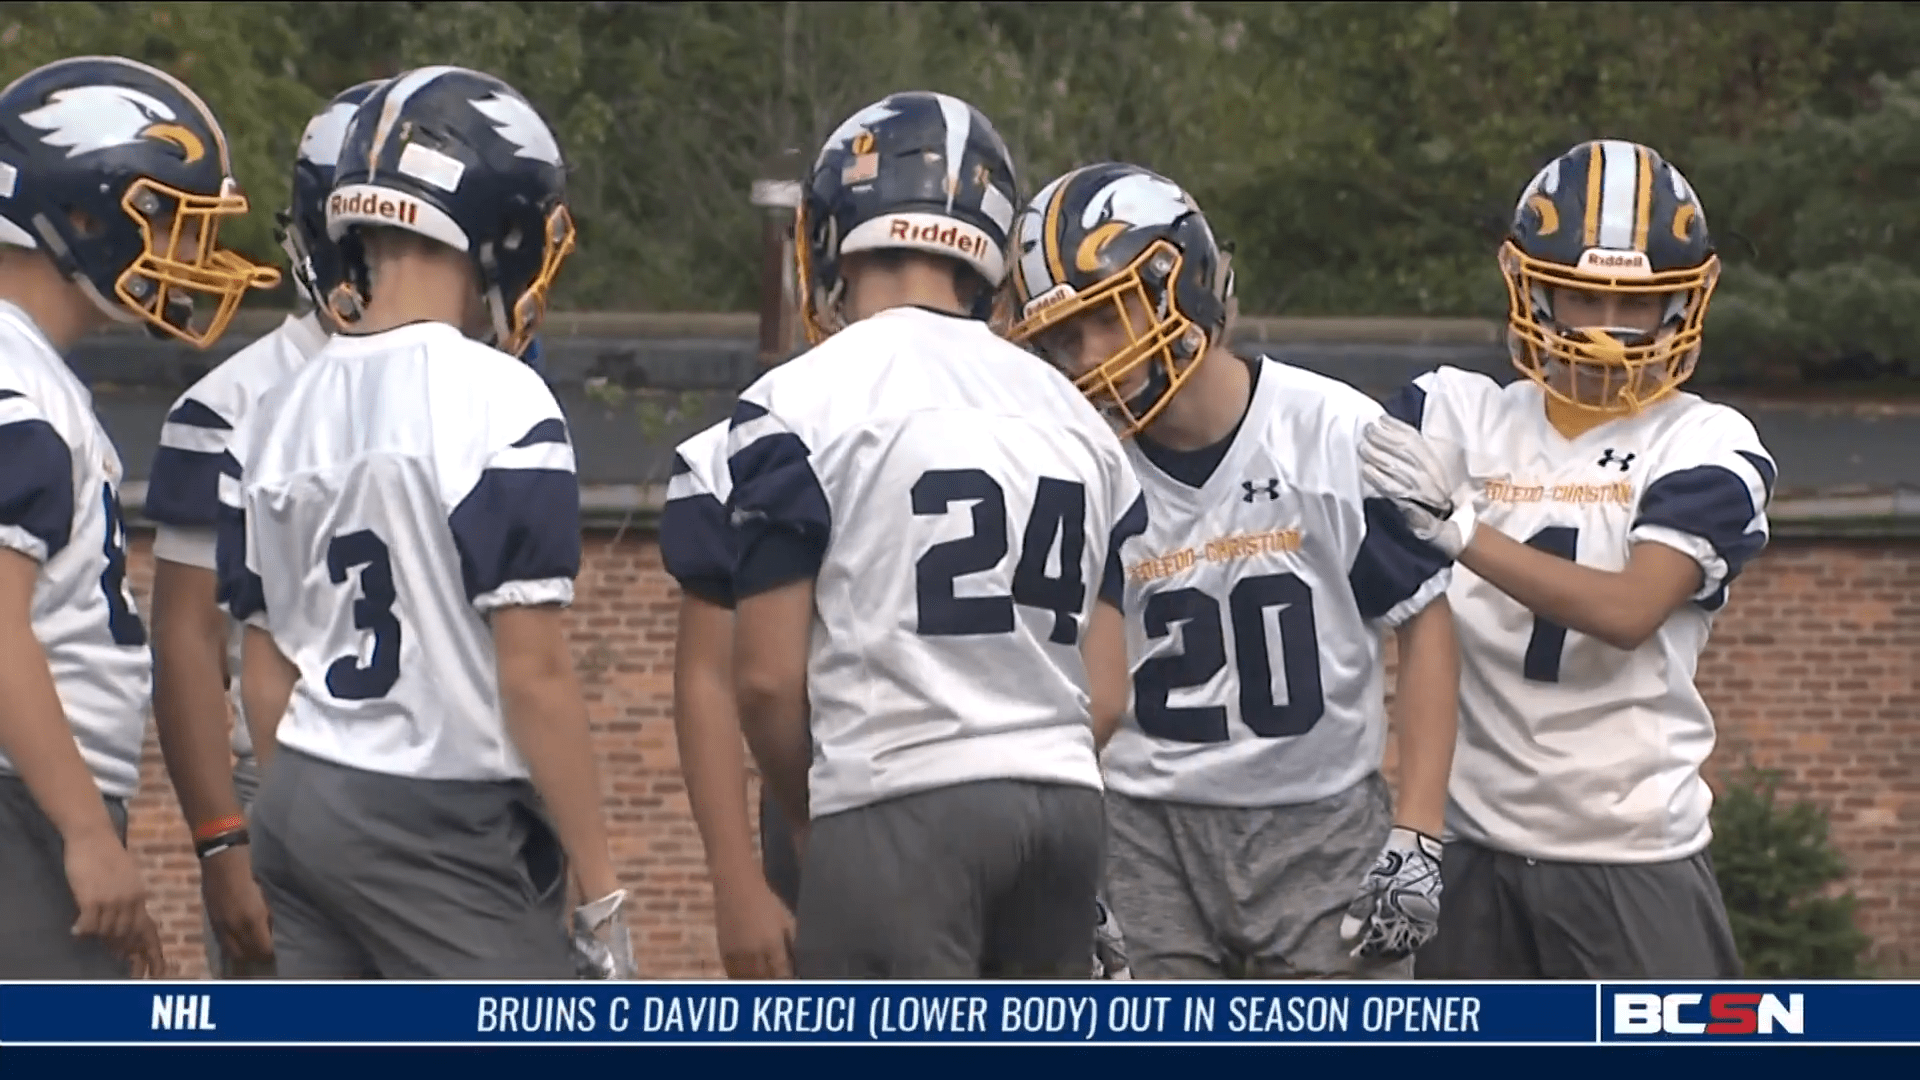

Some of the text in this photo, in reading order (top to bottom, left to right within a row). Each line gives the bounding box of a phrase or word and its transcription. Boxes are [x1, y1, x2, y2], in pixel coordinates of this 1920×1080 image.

[331, 193, 417, 225] Riddell
[890, 218, 988, 259] Riddell
[1588, 252, 1643, 268] Riddell
[910, 468, 1086, 646] 24
[326, 528, 402, 700] 3
[1133, 571, 1326, 743] 20
